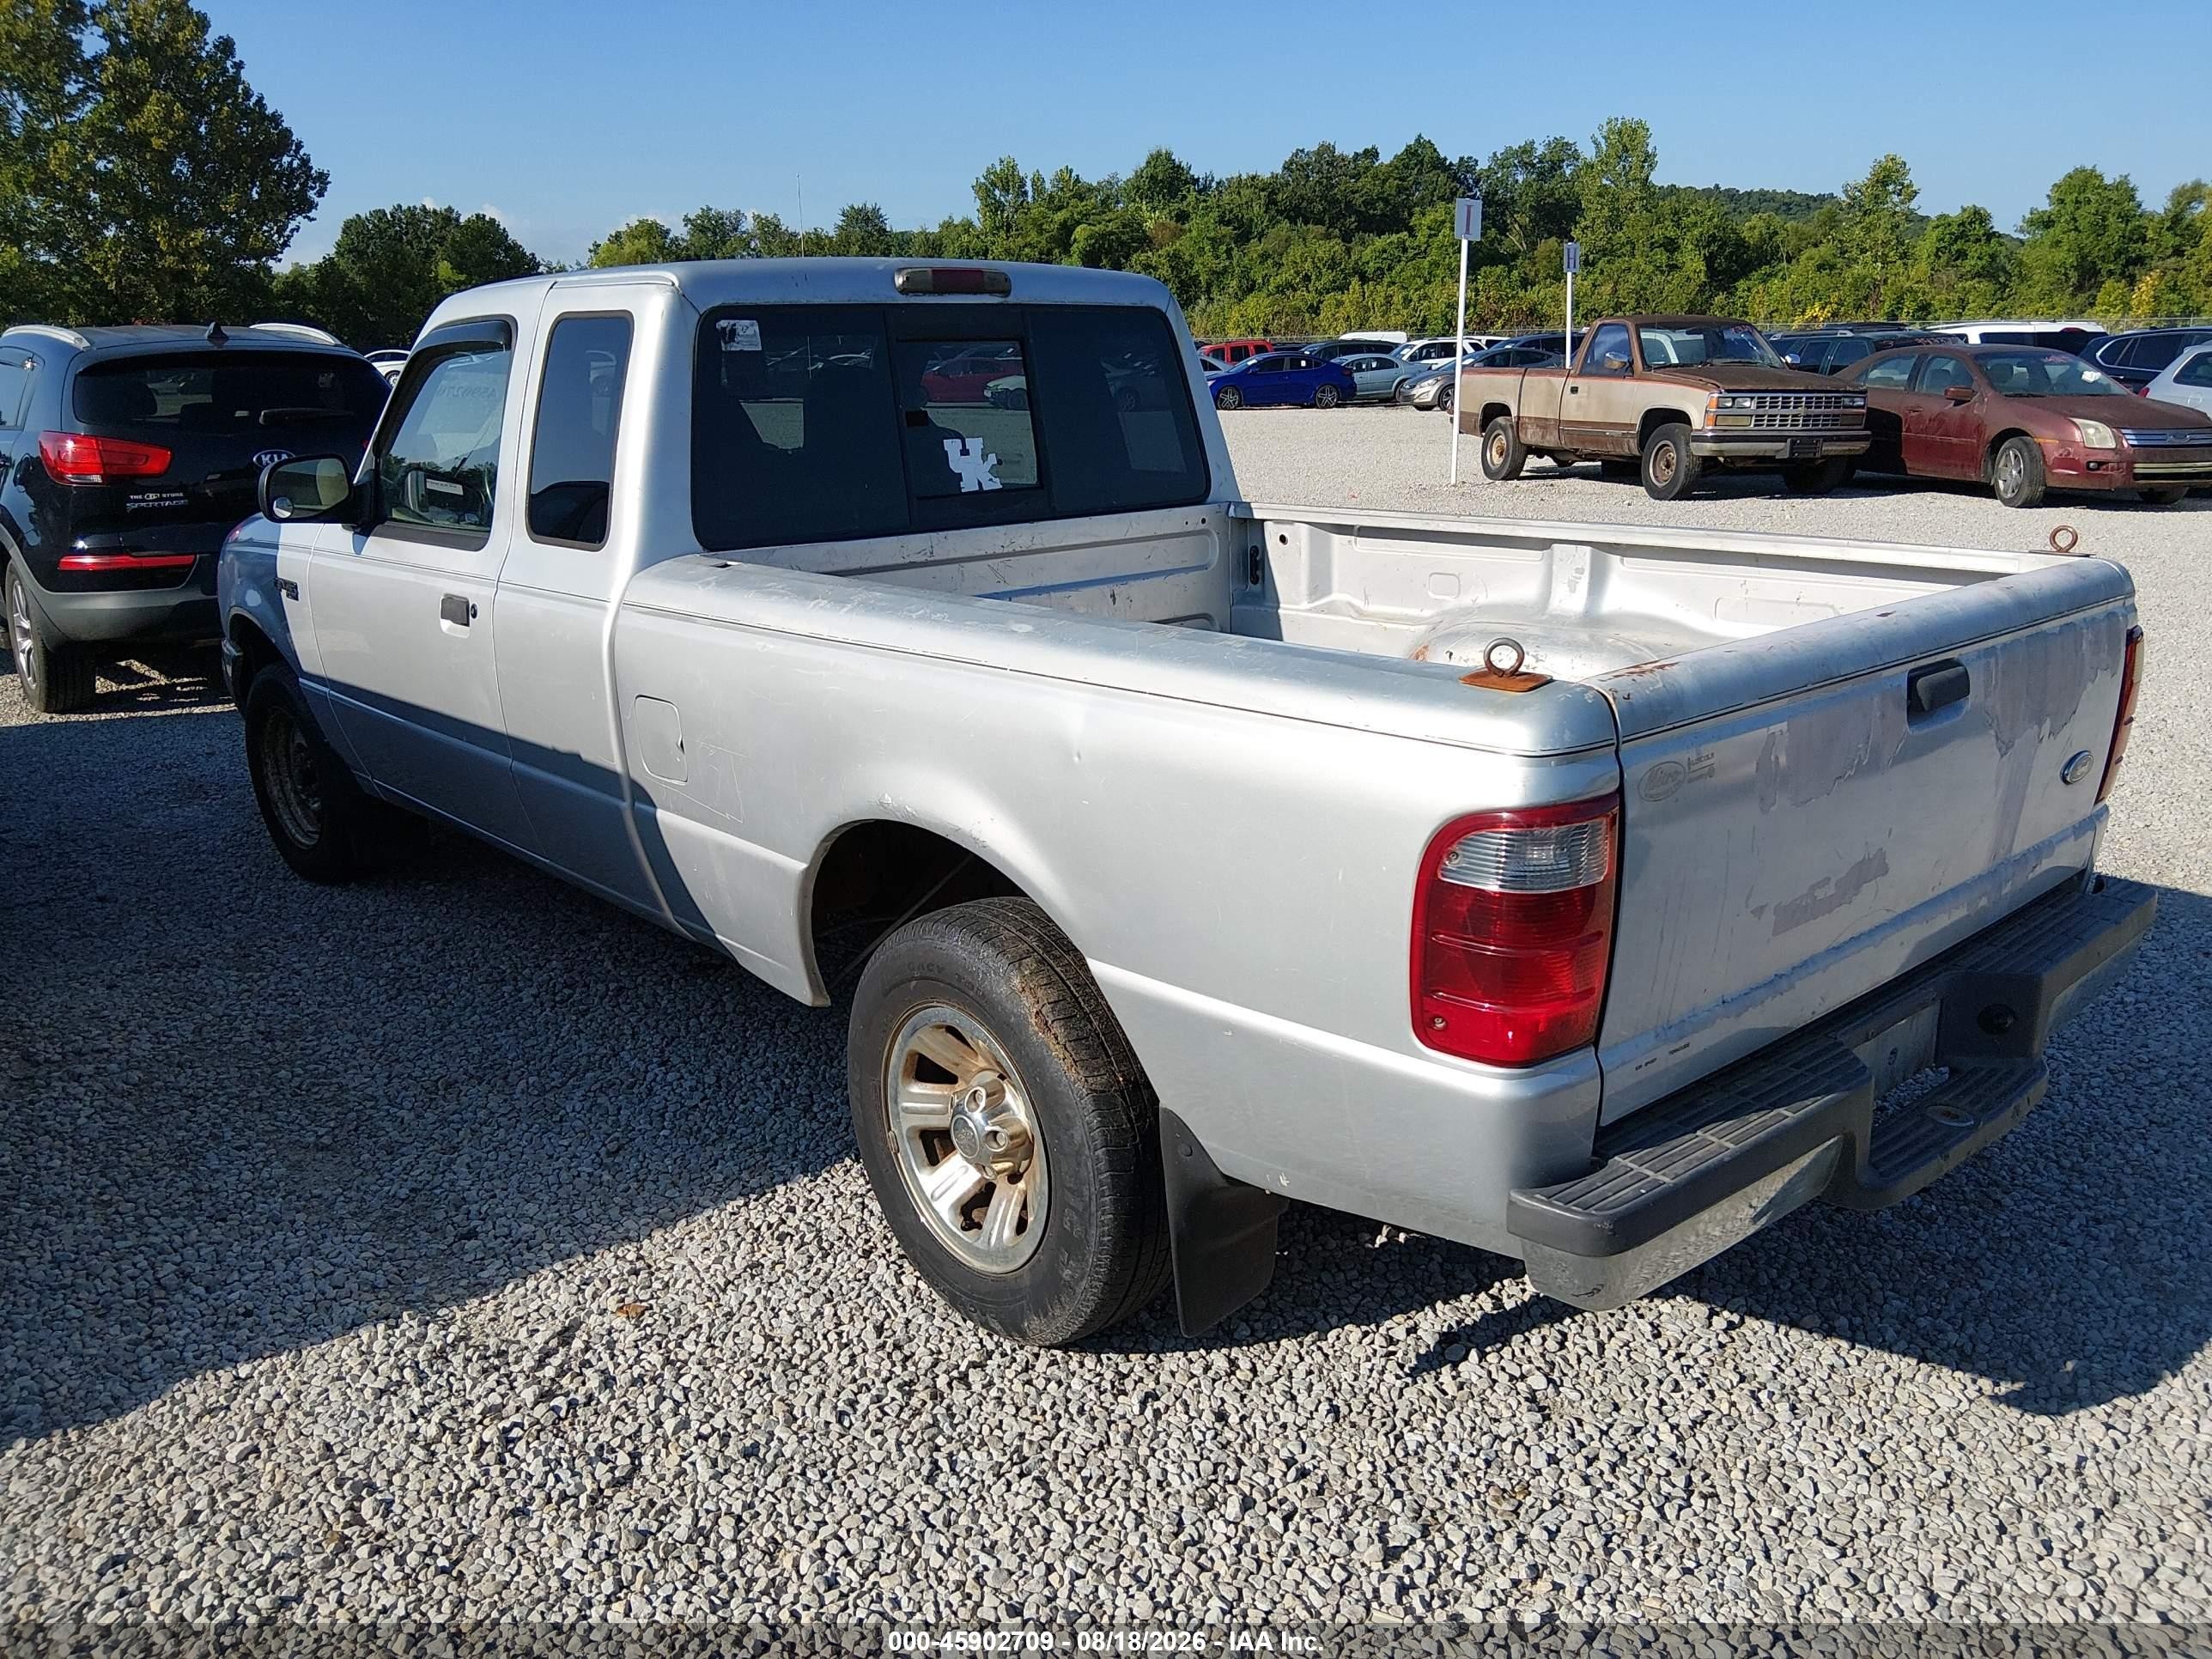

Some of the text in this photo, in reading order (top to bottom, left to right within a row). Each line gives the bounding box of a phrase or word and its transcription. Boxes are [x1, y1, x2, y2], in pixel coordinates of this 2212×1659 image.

[1464, 204, 1473, 234] I
[1566, 246, 1577, 269] H
[943, 437, 1003, 492] UK
